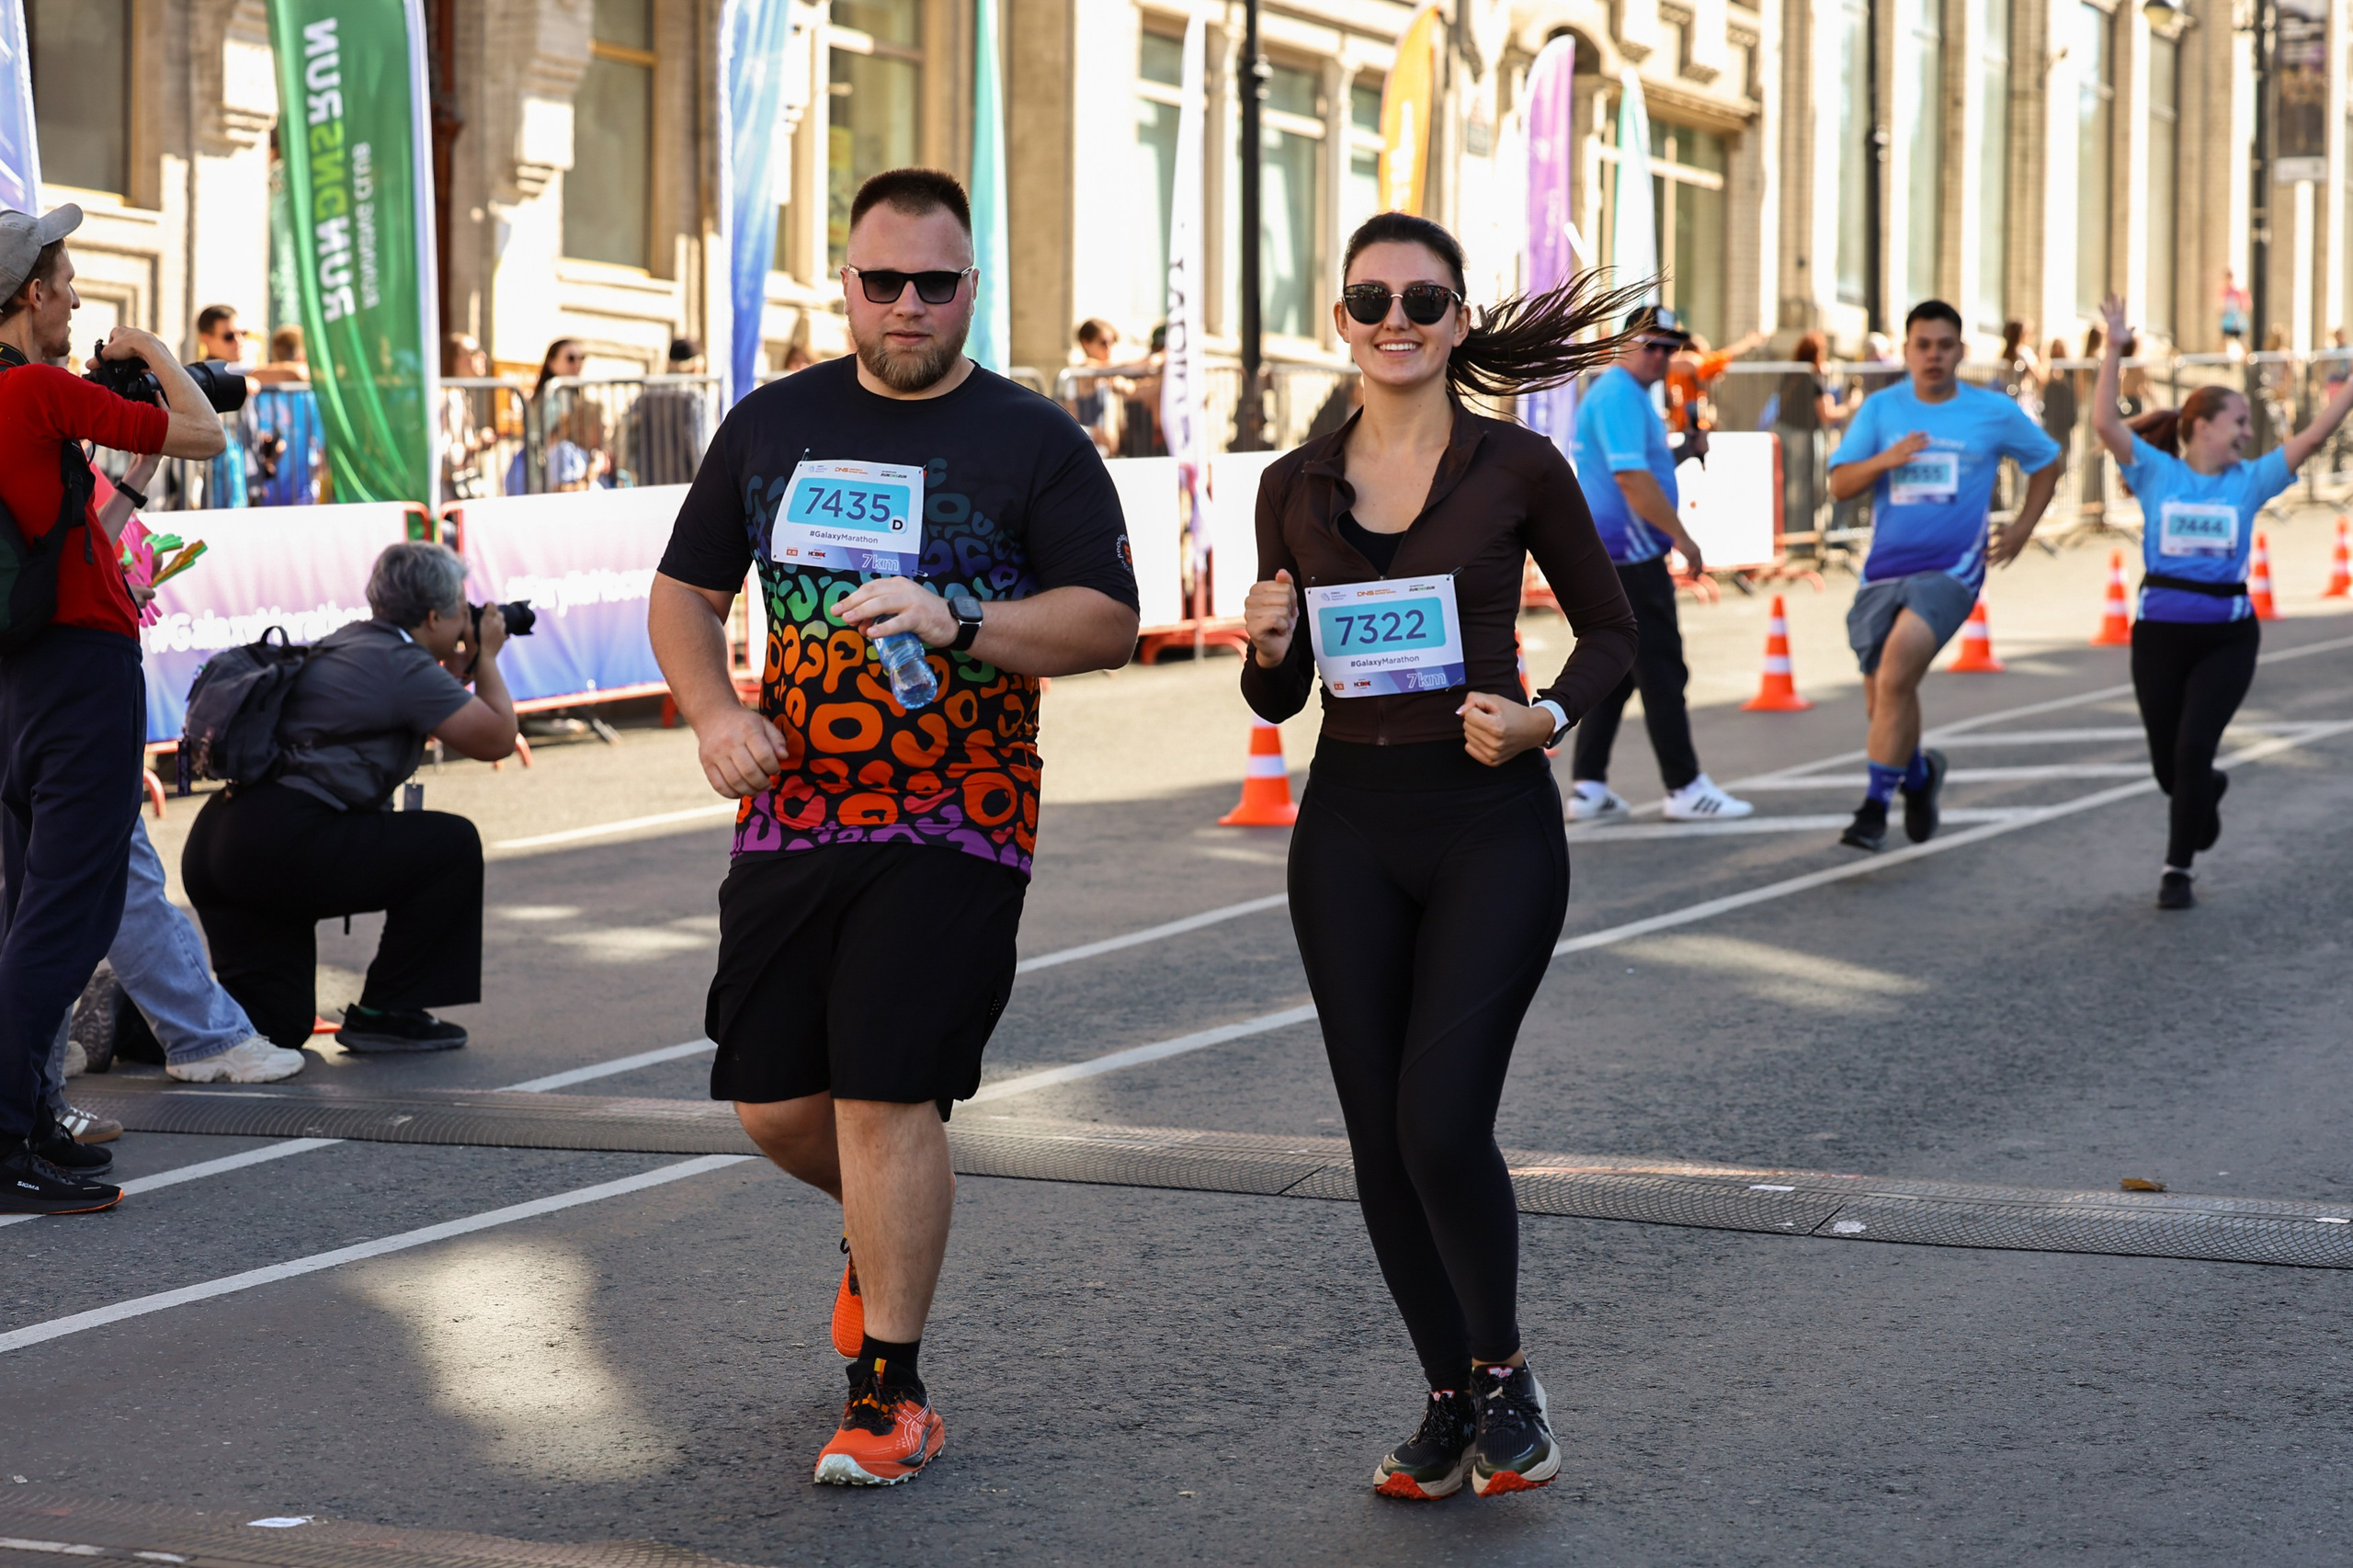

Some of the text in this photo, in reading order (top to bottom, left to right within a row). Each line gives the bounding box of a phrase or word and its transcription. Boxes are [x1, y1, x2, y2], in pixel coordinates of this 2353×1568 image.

[805, 487, 891, 523] 7435
[892, 519, 904, 530] D
[809, 530, 879, 545] #GalaxyMarathon
[1335, 609, 1427, 646] 7322
[1350, 654, 1420, 668] #GalaxyMarathon
